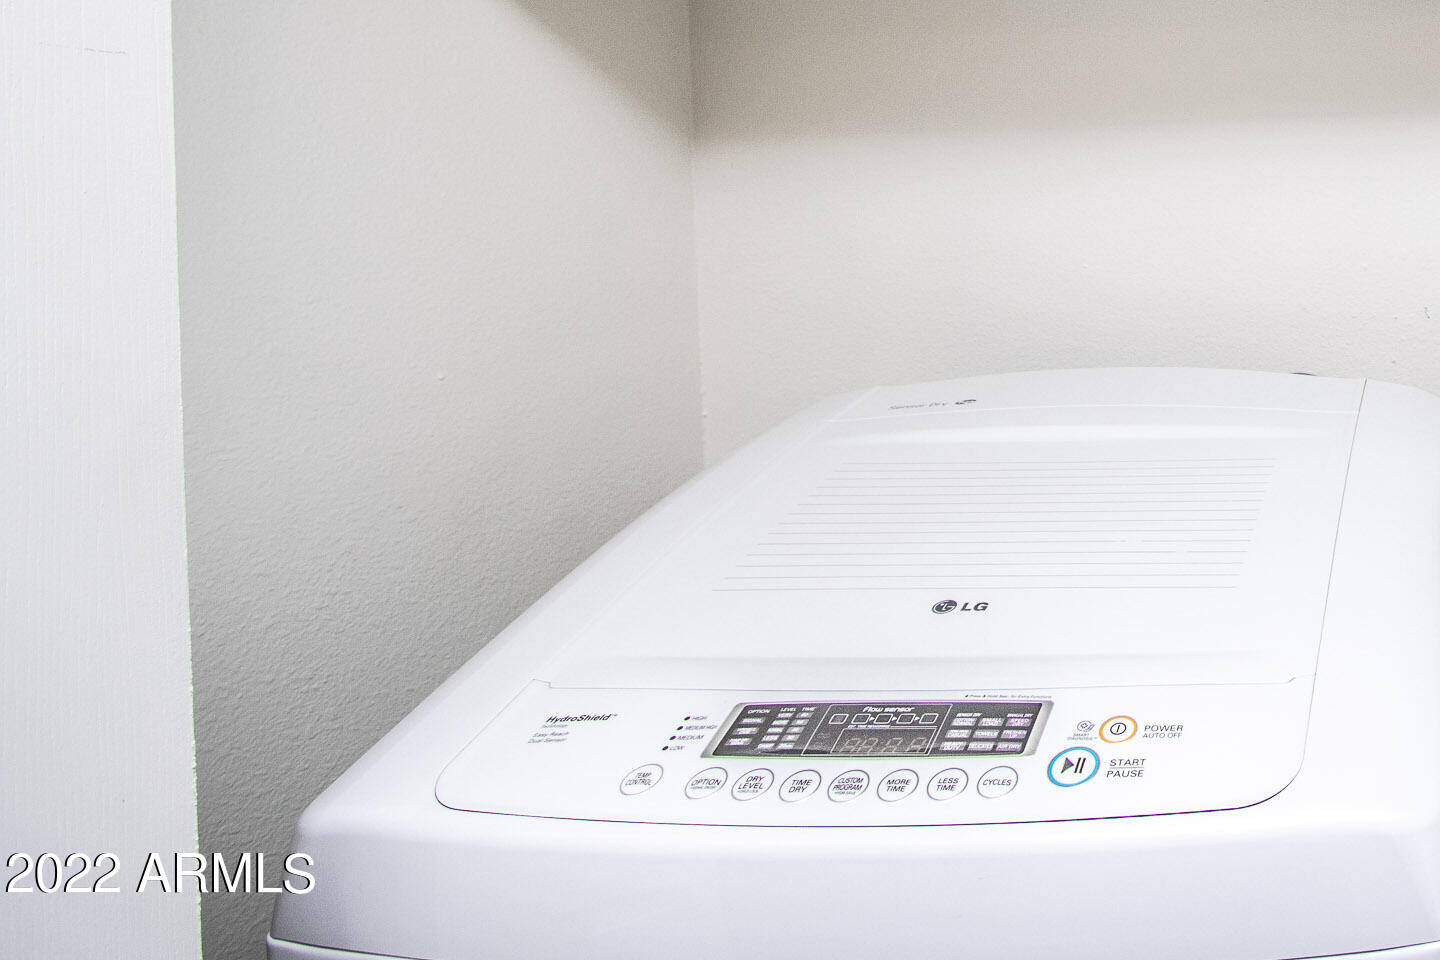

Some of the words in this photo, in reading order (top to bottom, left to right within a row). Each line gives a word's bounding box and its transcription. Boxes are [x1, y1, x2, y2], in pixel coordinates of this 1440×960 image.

[960, 602, 989, 611] LG
[546, 714, 612, 723] HydroShield
[1144, 724, 1184, 732] POWER
[1109, 758, 1147, 767] START
[1106, 770, 1145, 778] PAUSE
[690, 778, 722, 786] OPTION
[738, 782, 764, 790] LEVEL
